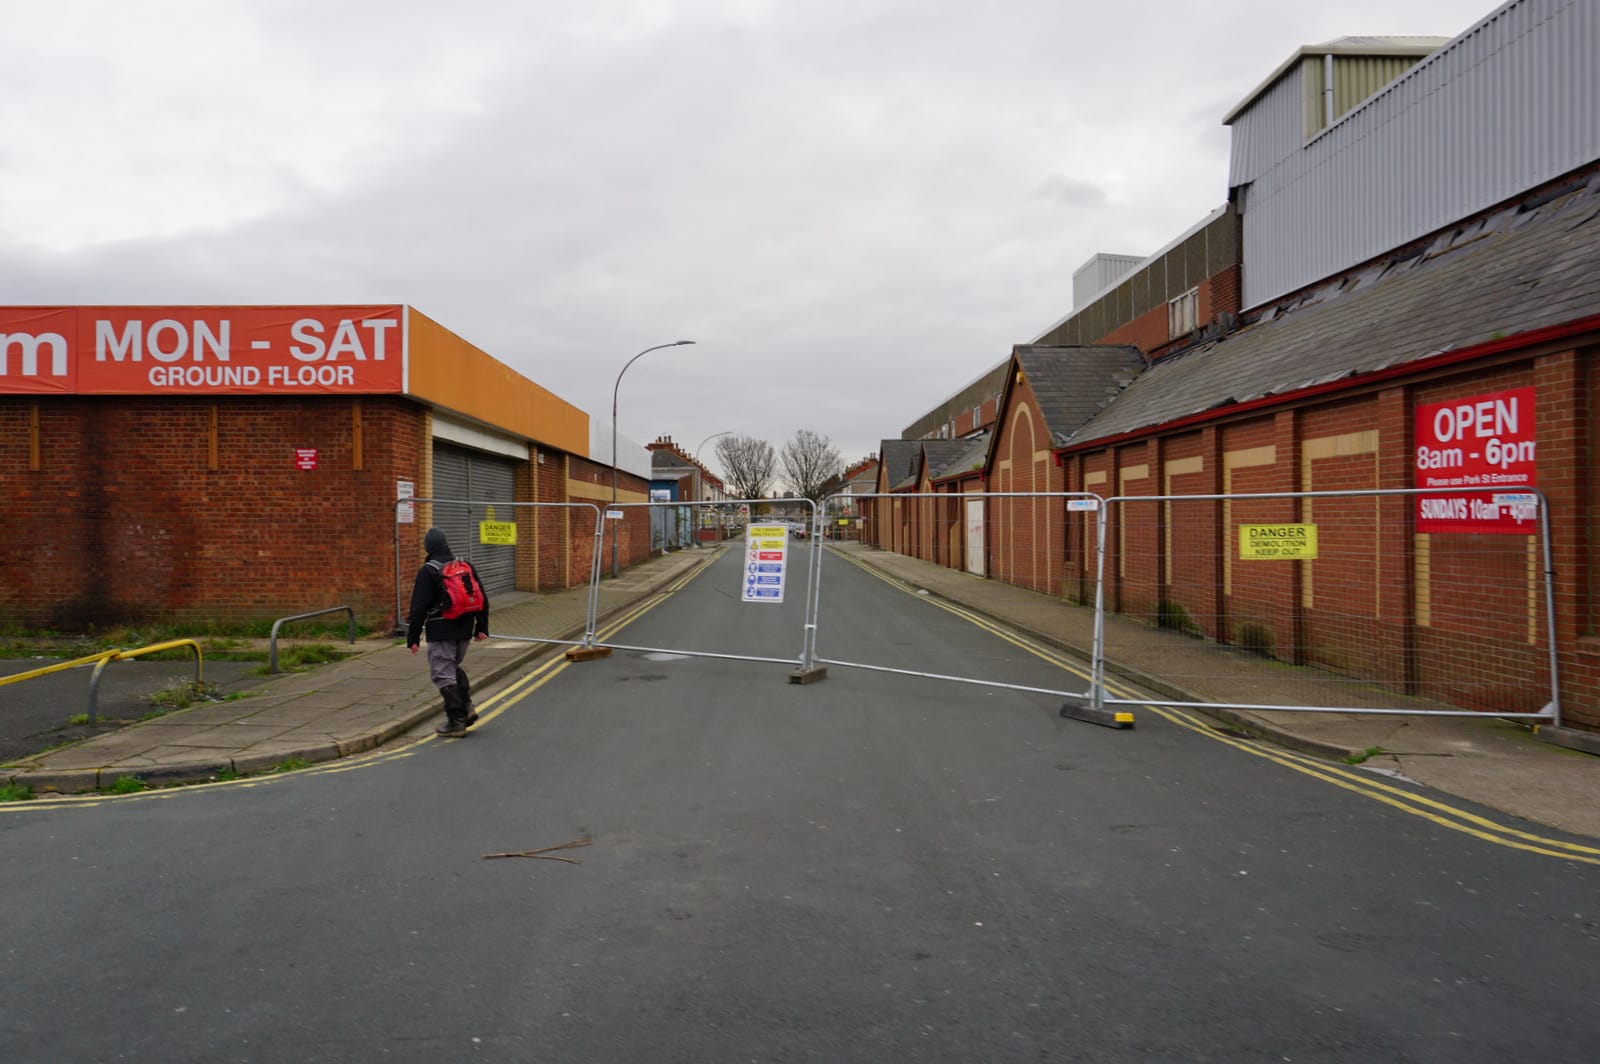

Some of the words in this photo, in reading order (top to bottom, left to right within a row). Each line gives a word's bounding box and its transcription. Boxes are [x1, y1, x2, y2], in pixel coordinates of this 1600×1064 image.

[95, 319, 230, 362] MON
[251, 340, 271, 350] -
[289, 318, 398, 362] SAT
[148, 366, 260, 387] GROUND
[269, 365, 354, 386] FLOOR
[1433, 397, 1518, 443] OPEN
[1417, 446, 1463, 470] 8am
[1464, 475, 1480, 484] Park
[1491, 473, 1528, 483] Entrance
[1421, 498, 1468, 519] SUNDAYS
[1470, 498, 1499, 520] 10am
[1249, 527, 1306, 538] DANGER
[1250, 540, 1306, 548] DEMOLITION
[1255, 548, 1280, 556] KEEP
[1281, 547, 1301, 555] OUT
